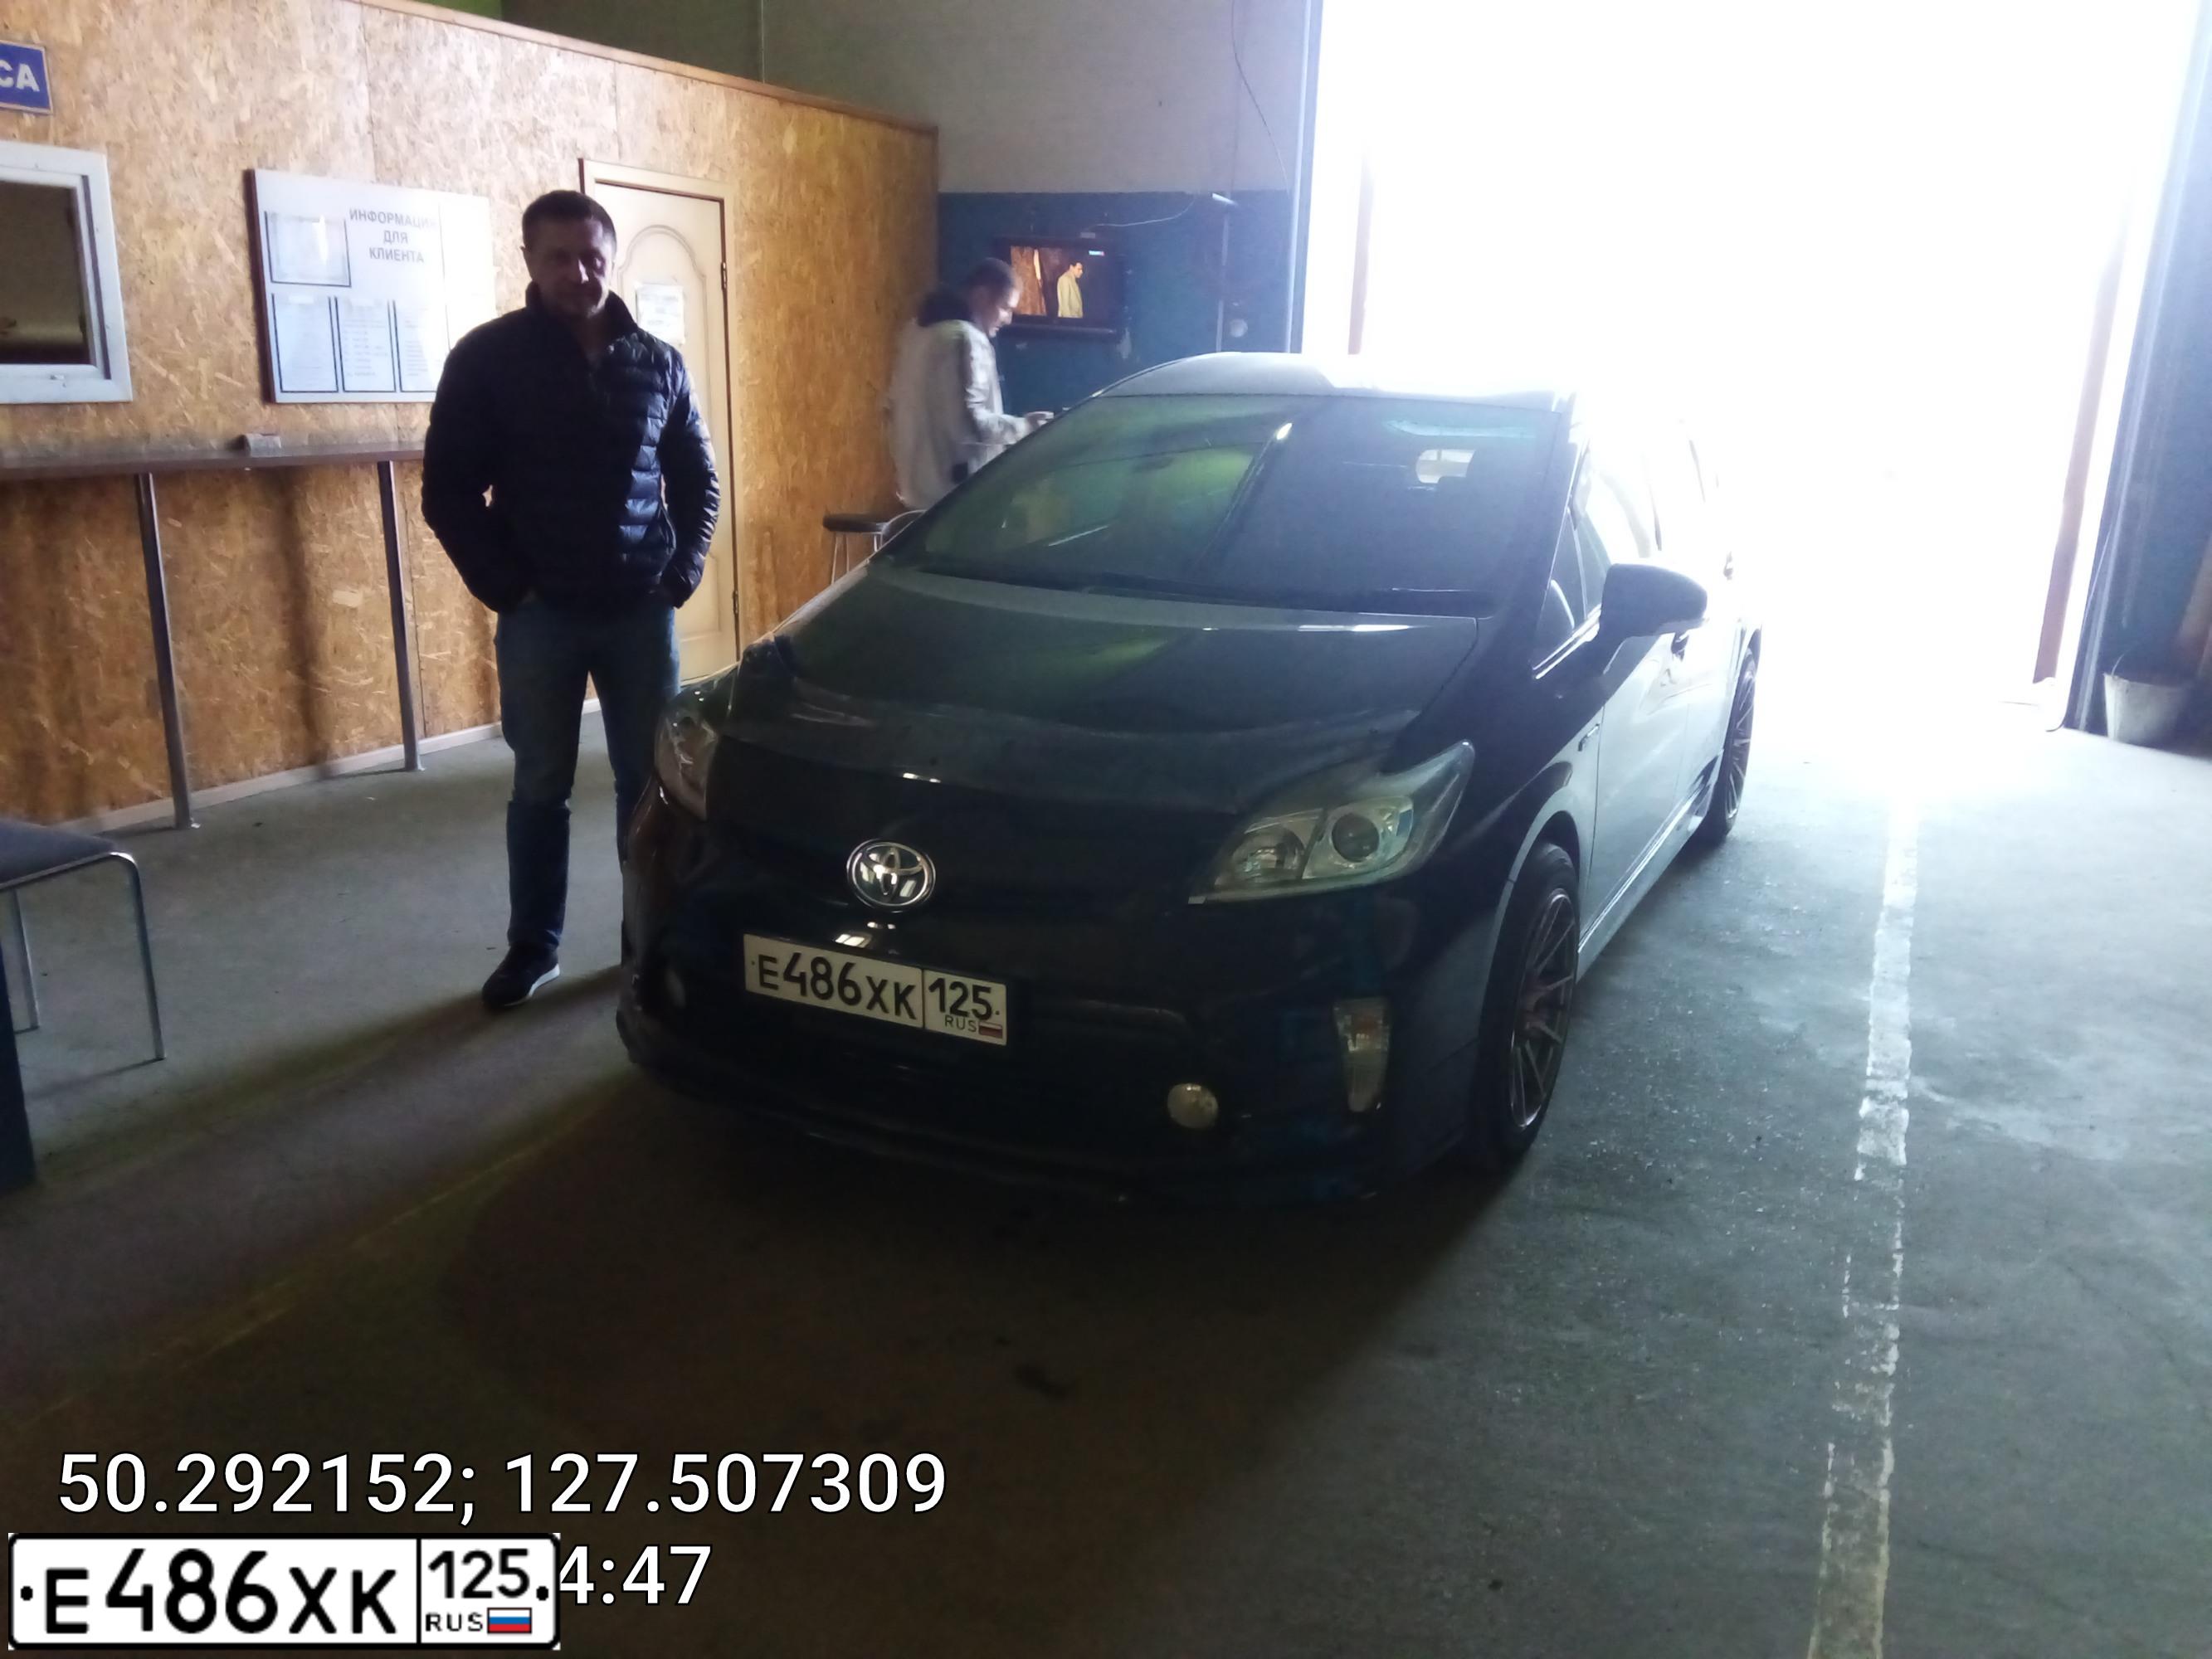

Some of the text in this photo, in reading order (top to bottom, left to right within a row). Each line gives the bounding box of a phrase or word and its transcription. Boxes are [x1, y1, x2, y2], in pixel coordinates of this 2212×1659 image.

[382, 230, 408, 245] ДЛЯ
[368, 247, 425, 264] КЛИЕНТА
[758, 951, 993, 1021] Е486ХК 125
[944, 1014, 977, 1034] RUS
